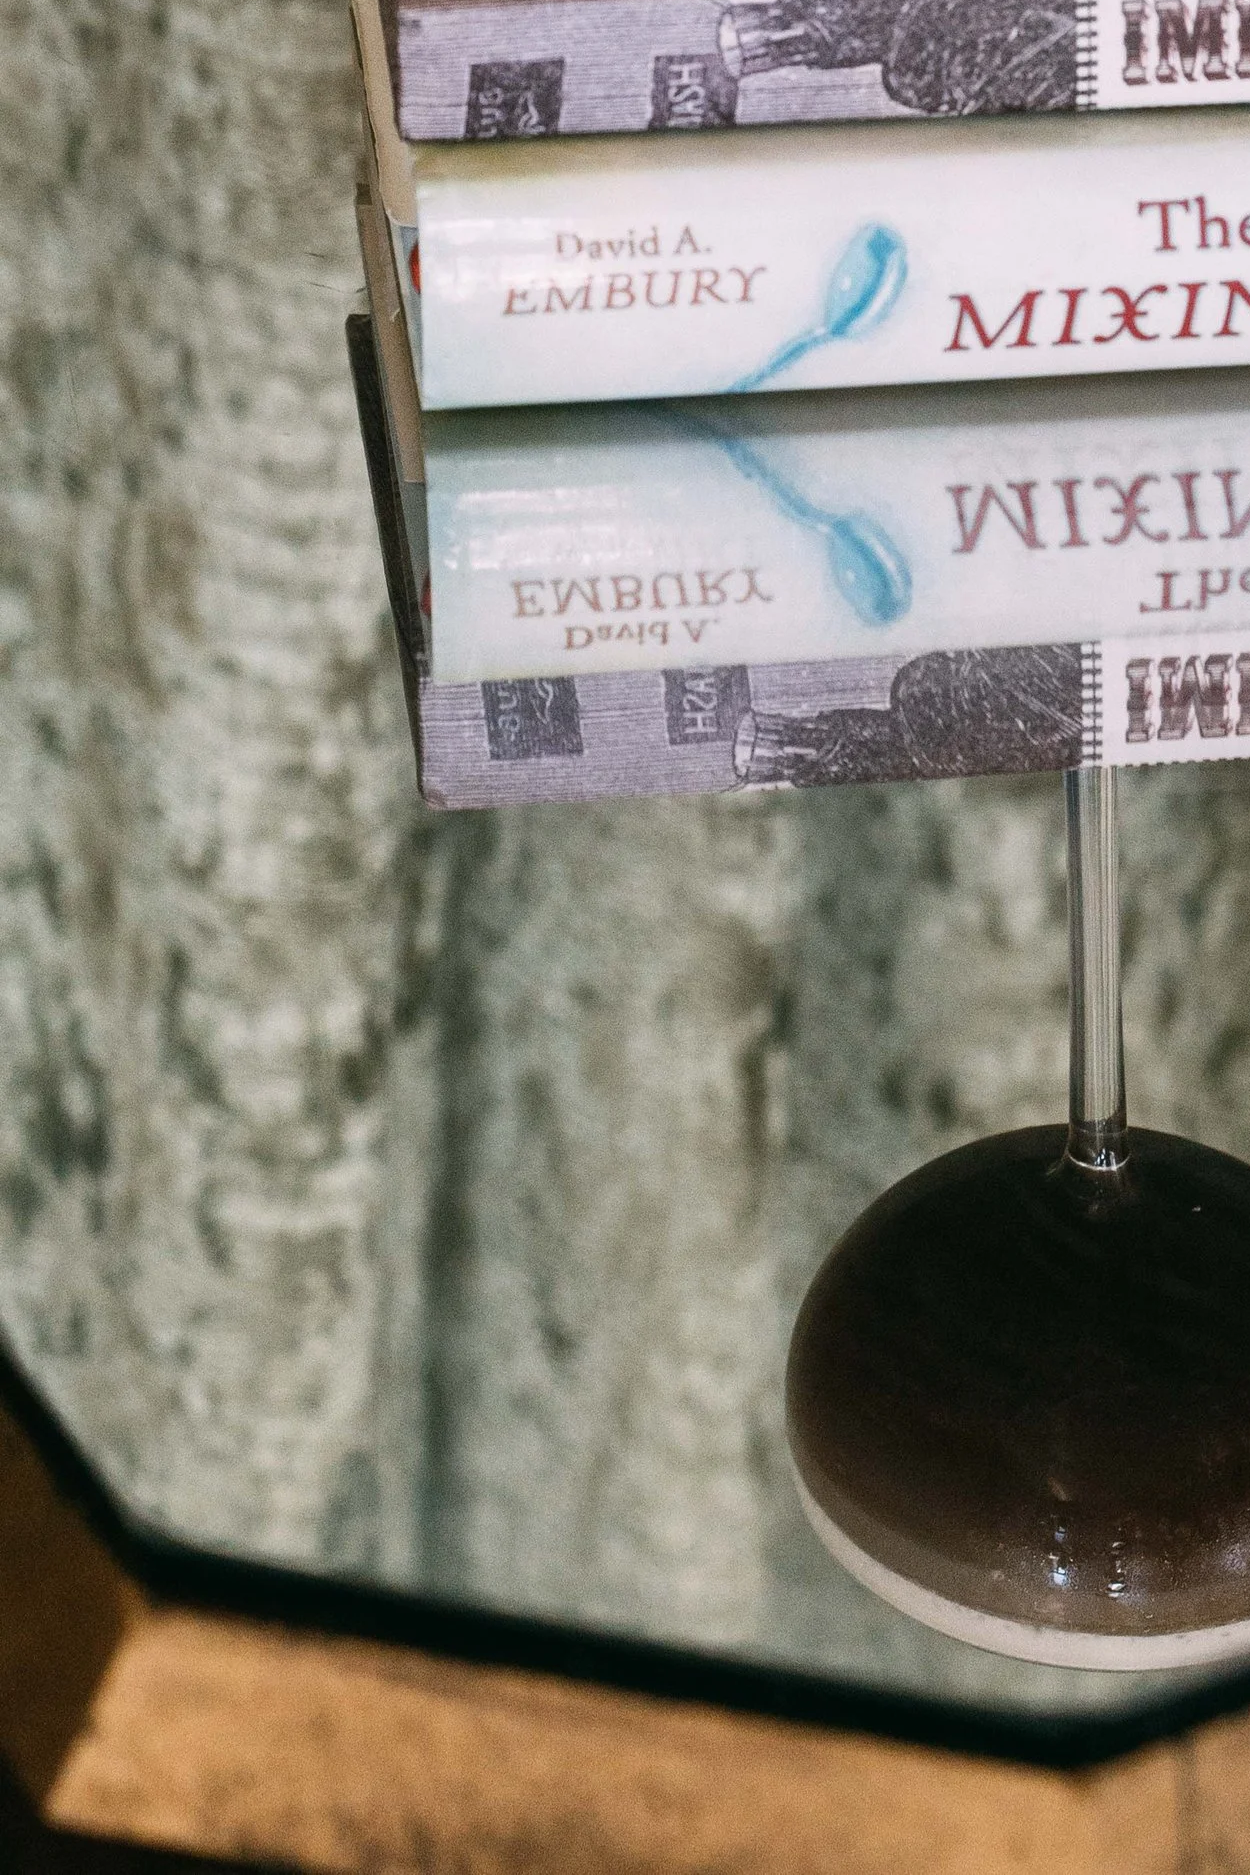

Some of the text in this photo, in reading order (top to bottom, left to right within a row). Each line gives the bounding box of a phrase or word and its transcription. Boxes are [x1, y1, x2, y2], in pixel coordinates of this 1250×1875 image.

[555, 224, 713, 260] David A.
[502, 265, 768, 316] EMBURY
